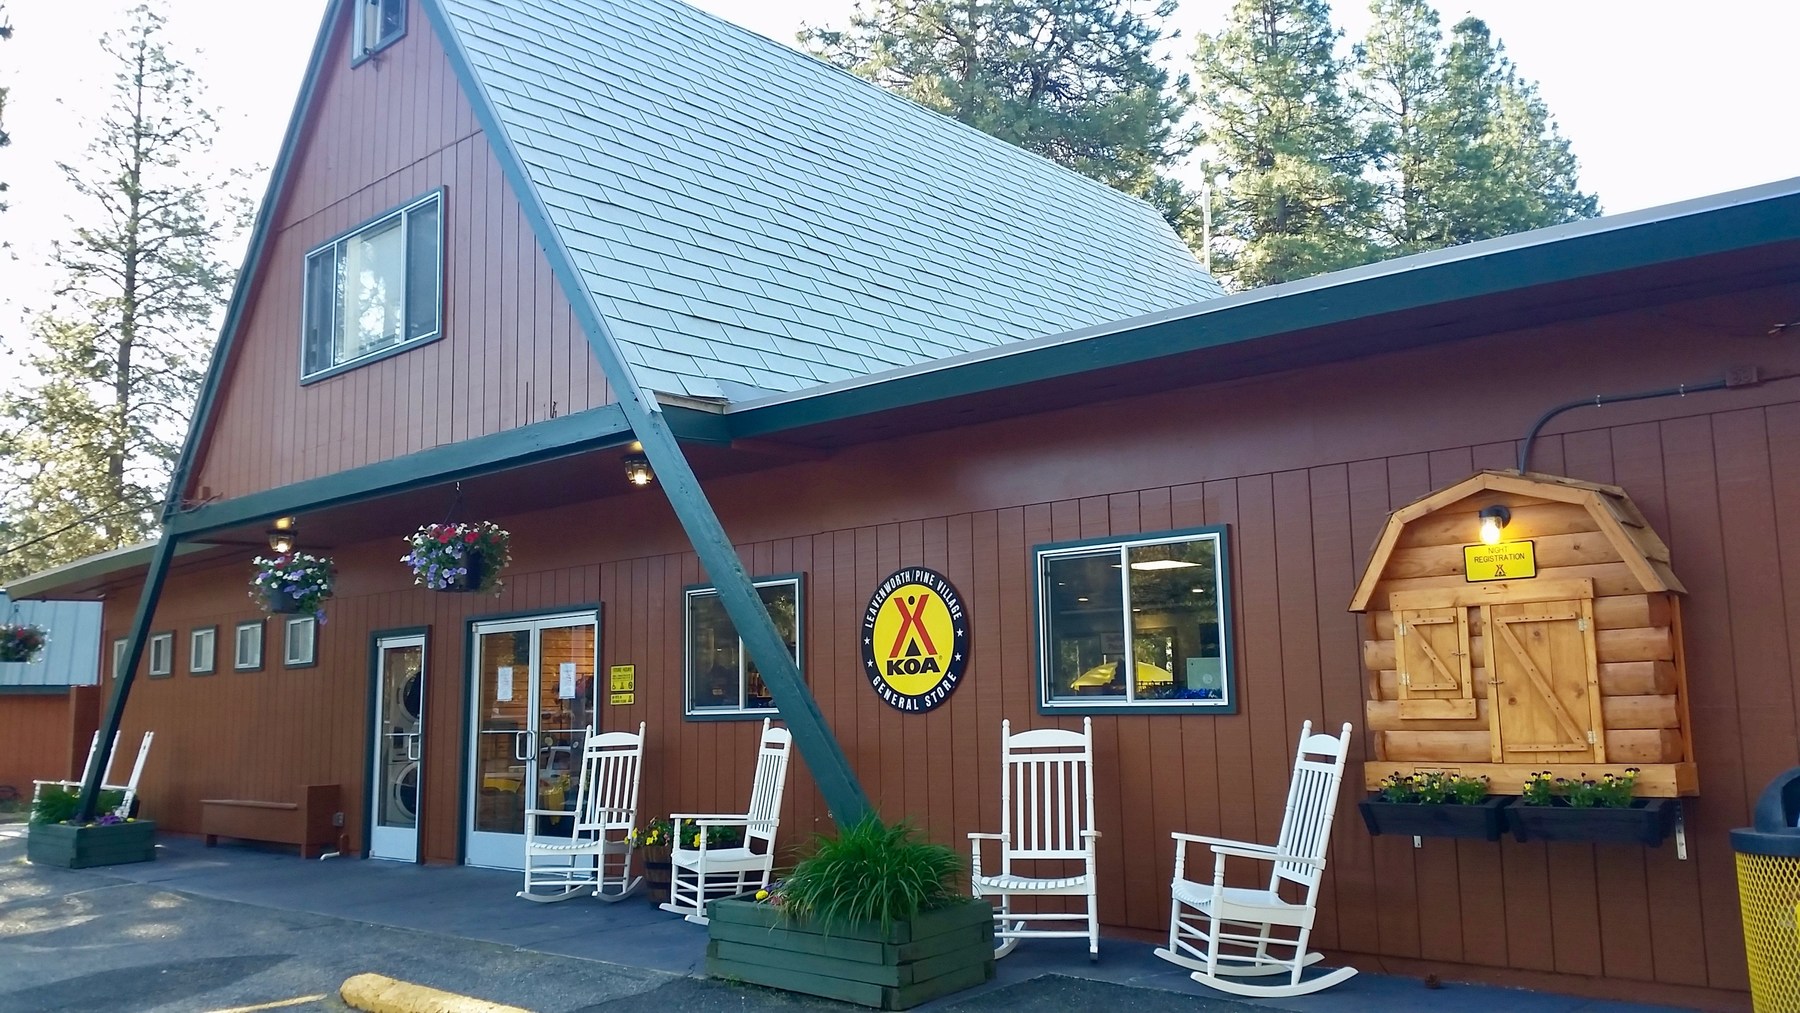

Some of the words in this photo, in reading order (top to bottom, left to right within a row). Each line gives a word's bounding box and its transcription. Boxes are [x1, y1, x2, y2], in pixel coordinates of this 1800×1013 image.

[1474, 553, 1525, 563] REGISTRATION
[1488, 546, 1508, 554] NIGHT
[936, 580, 963, 621] VILLAGE
[886, 658, 940, 676] KOA
[872, 675, 919, 711] GENERAL
[924, 671, 957, 708] STORE
